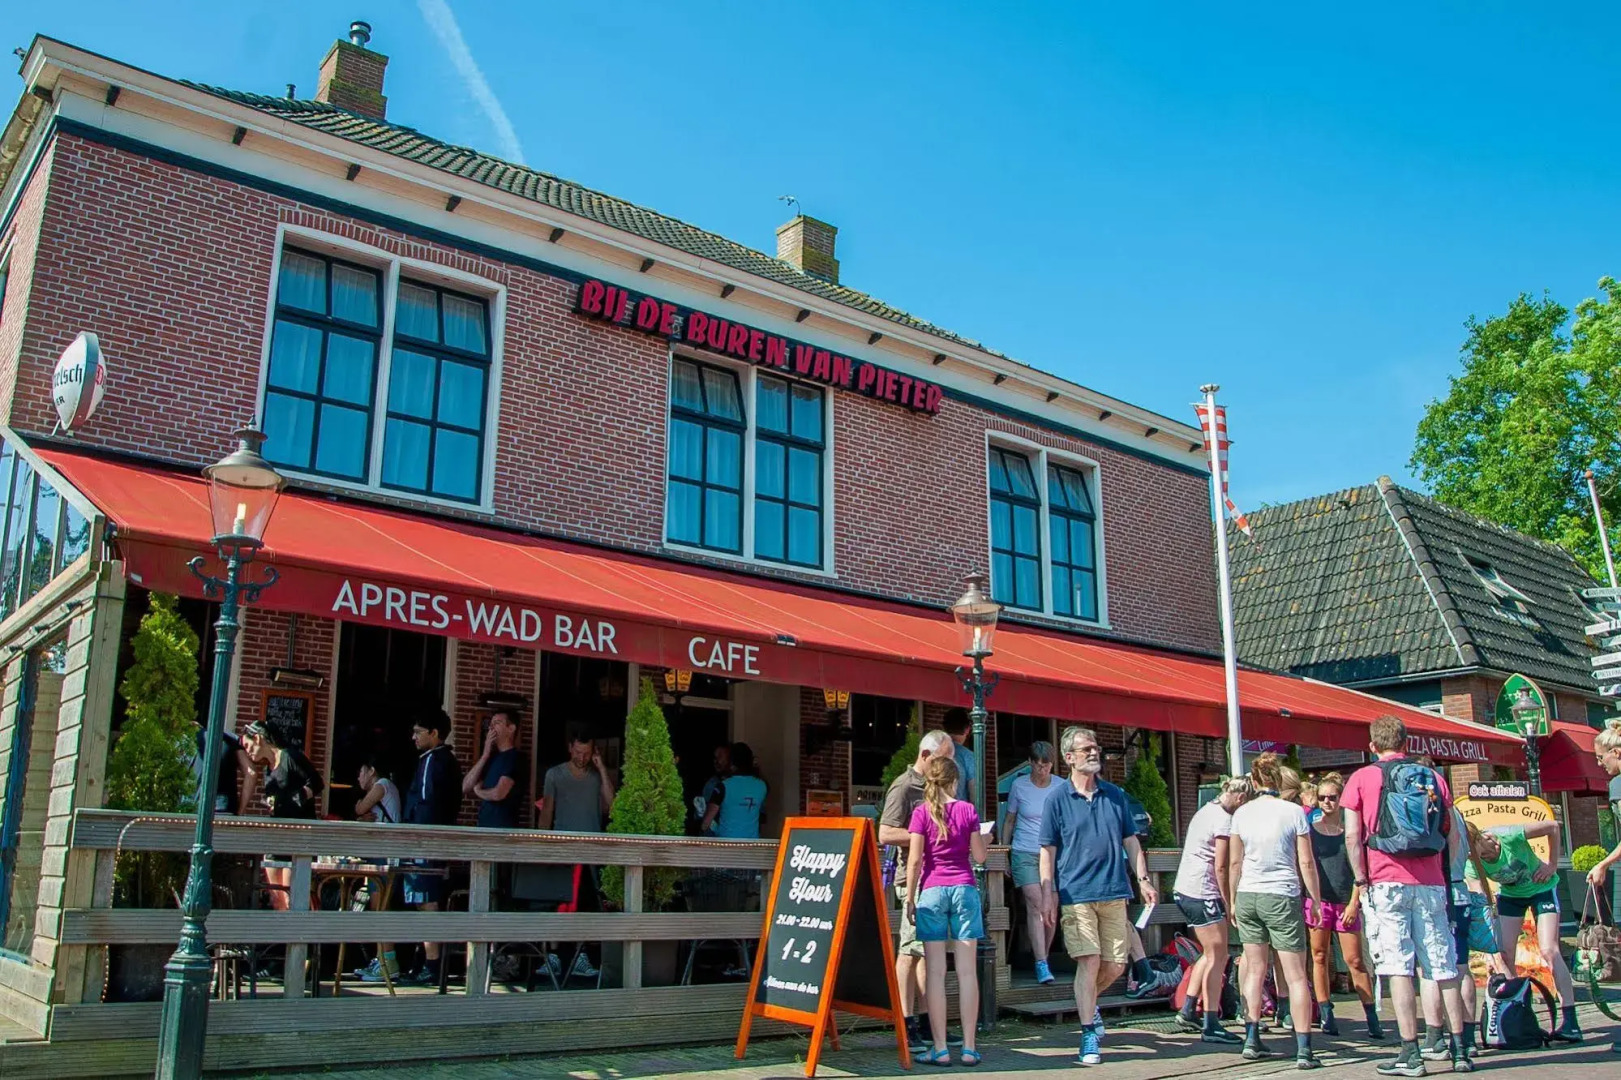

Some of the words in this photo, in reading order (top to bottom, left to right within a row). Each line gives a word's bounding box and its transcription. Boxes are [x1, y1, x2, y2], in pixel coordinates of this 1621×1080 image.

[583, 280, 628, 322] BIJ
[637, 297, 678, 335] DE
[687, 312, 788, 367] BUREN
[796, 345, 851, 386] VAN
[859, 364, 943, 414] PIETER
[331, 579, 542, 642] APRES-WAD
[554, 615, 618, 654] BAR
[688, 637, 760, 675] CAFE
[1405, 735, 1430, 755] IZZA
[1429, 737, 1460, 758] PASTA
[1460, 741, 1489, 760] GRILL
[1469, 784, 1489, 796] Ook
[1489, 784, 1525, 797] afhalen
[1487, 803, 1516, 814] Pasta
[1521, 806, 1547, 822] Grill
[790, 844, 845, 878] Happy
[789, 876, 833, 904] Hour
